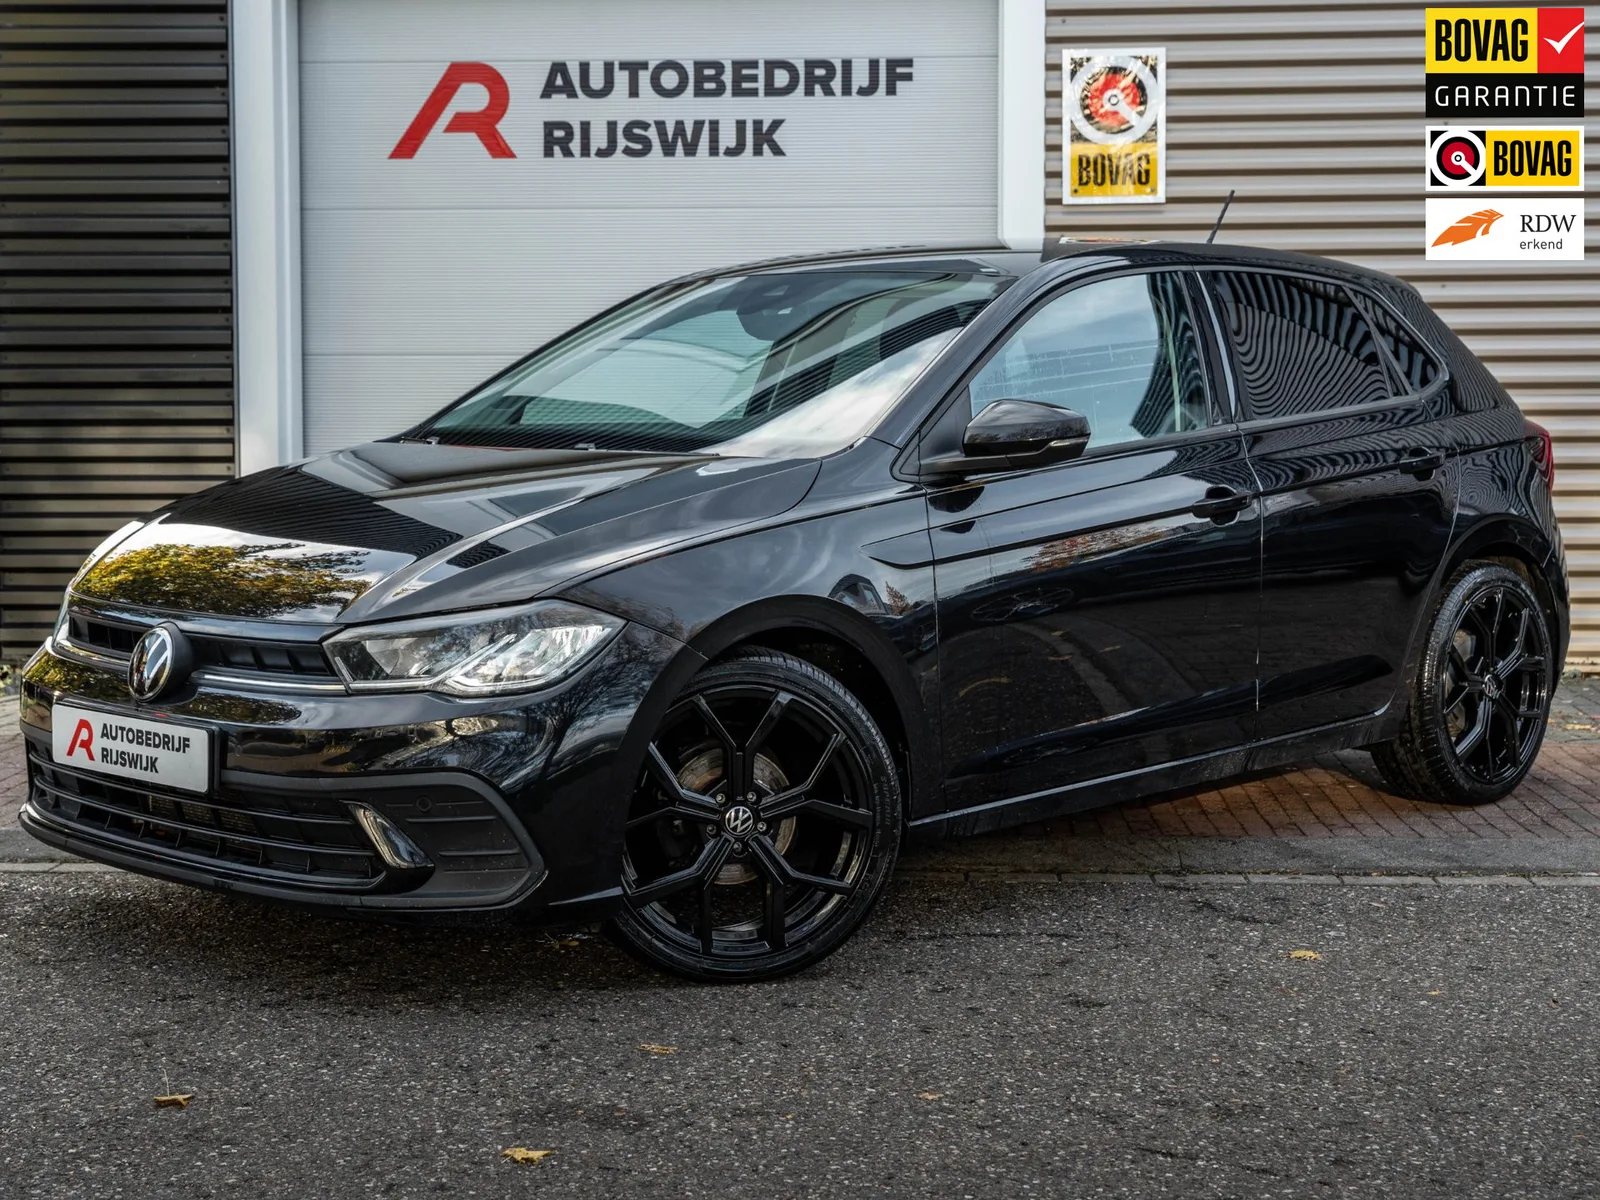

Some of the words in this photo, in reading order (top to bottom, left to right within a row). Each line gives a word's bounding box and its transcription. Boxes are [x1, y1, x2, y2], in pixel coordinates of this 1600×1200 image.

[540, 57, 914, 99] AUTOBEDRIJF
[543, 118, 787, 158] RIJSWIJK
[1077, 153, 1151, 186] BOVAG
[100, 723, 191, 754] AUTOBEDRIJF
[101, 748, 159, 774] RIJSWIJK
